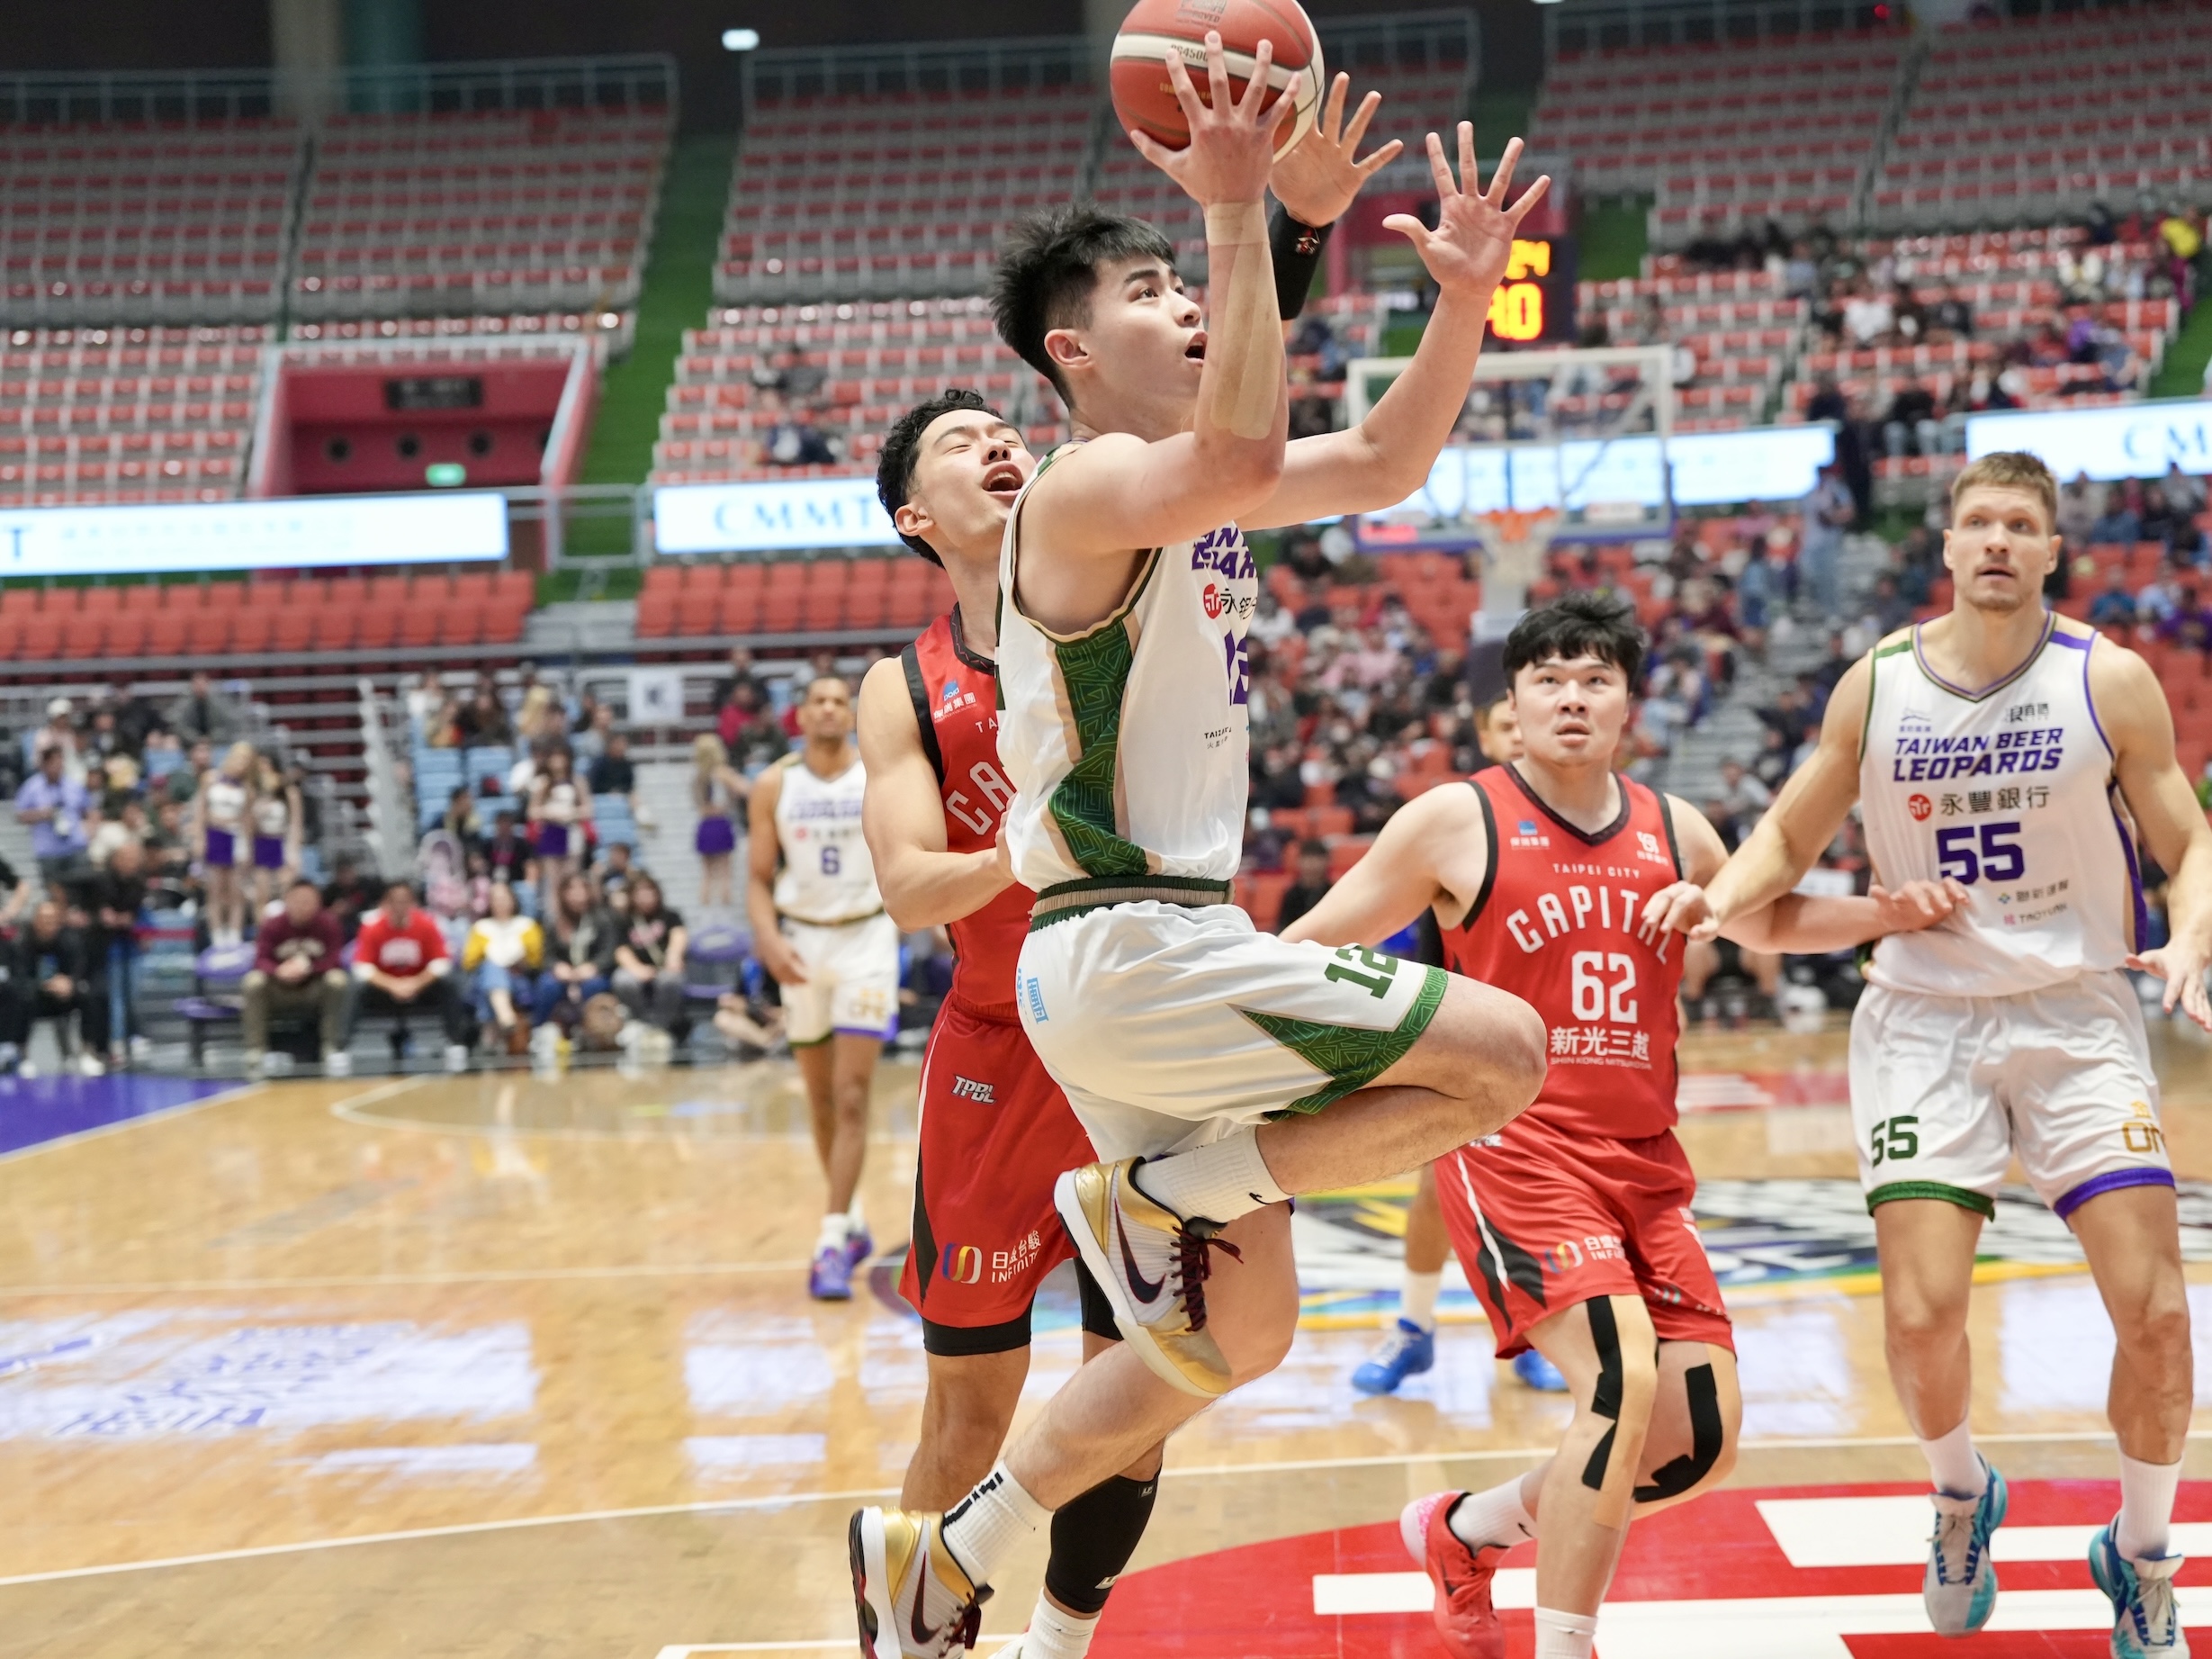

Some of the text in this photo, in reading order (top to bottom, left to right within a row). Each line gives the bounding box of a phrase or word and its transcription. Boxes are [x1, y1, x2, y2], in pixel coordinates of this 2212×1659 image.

[1896, 727, 2064, 755] TAIWAN BEER
[1893, 748, 2064, 781] LEOPARDS
[1941, 786, 2050, 816] 永豐銀行
[821, 846, 841, 875] 6
[1937, 822, 2025, 885] 55
[1552, 863, 1641, 879] TAIPEI CITY
[1324, 945, 1398, 999] 12
[1572, 951, 1638, 1024] 62
[1551, 1026, 1650, 1060] 新光三越
[951, 1075, 997, 1104] TPBL
[1872, 1115, 1919, 1168] 55
